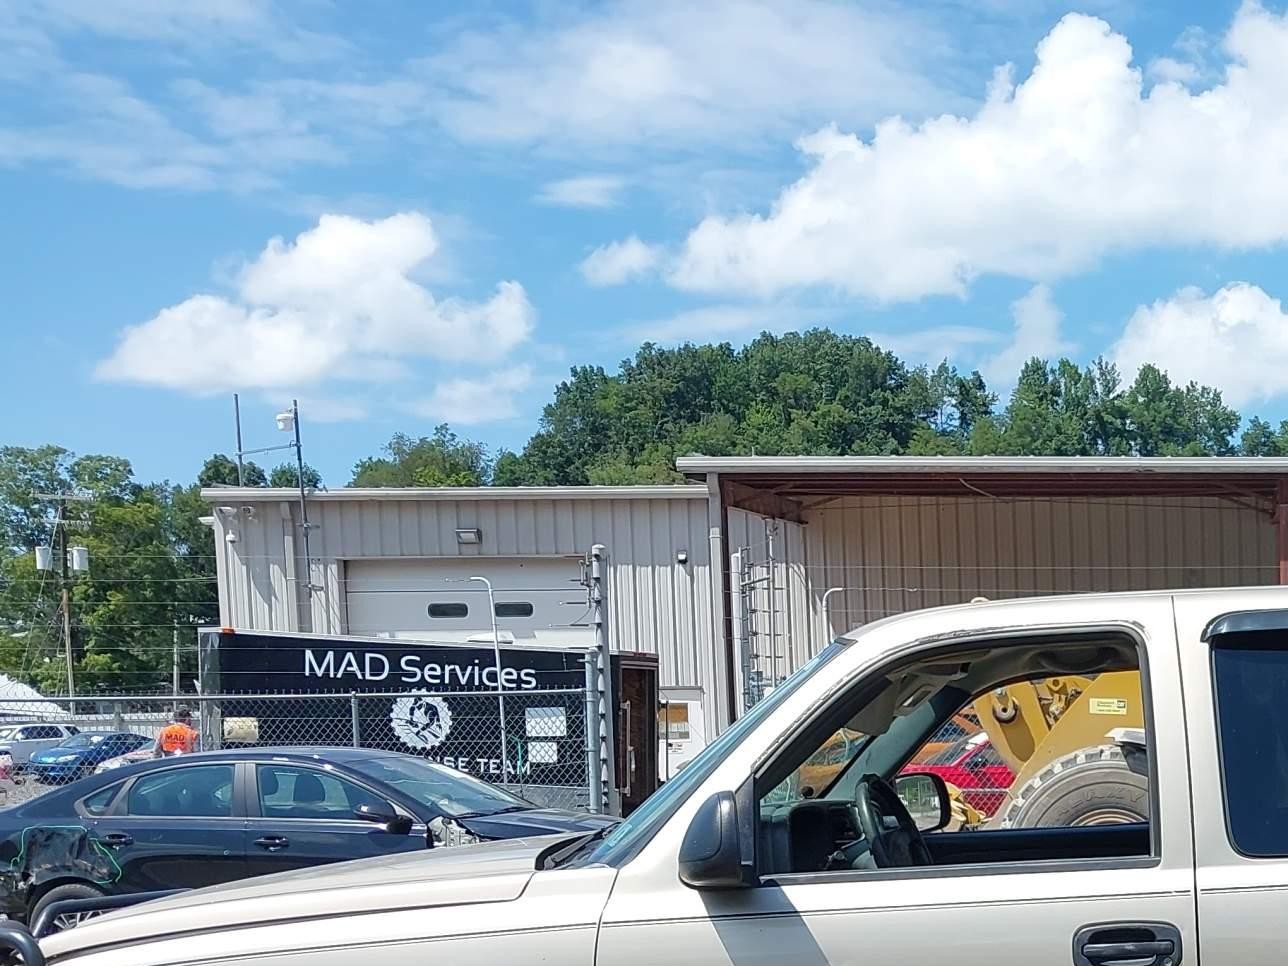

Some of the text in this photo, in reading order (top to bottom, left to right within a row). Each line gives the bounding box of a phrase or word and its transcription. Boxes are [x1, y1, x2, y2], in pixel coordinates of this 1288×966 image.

[304, 649, 537, 689] MAD Services
[476, 757, 532, 775] TEAM
